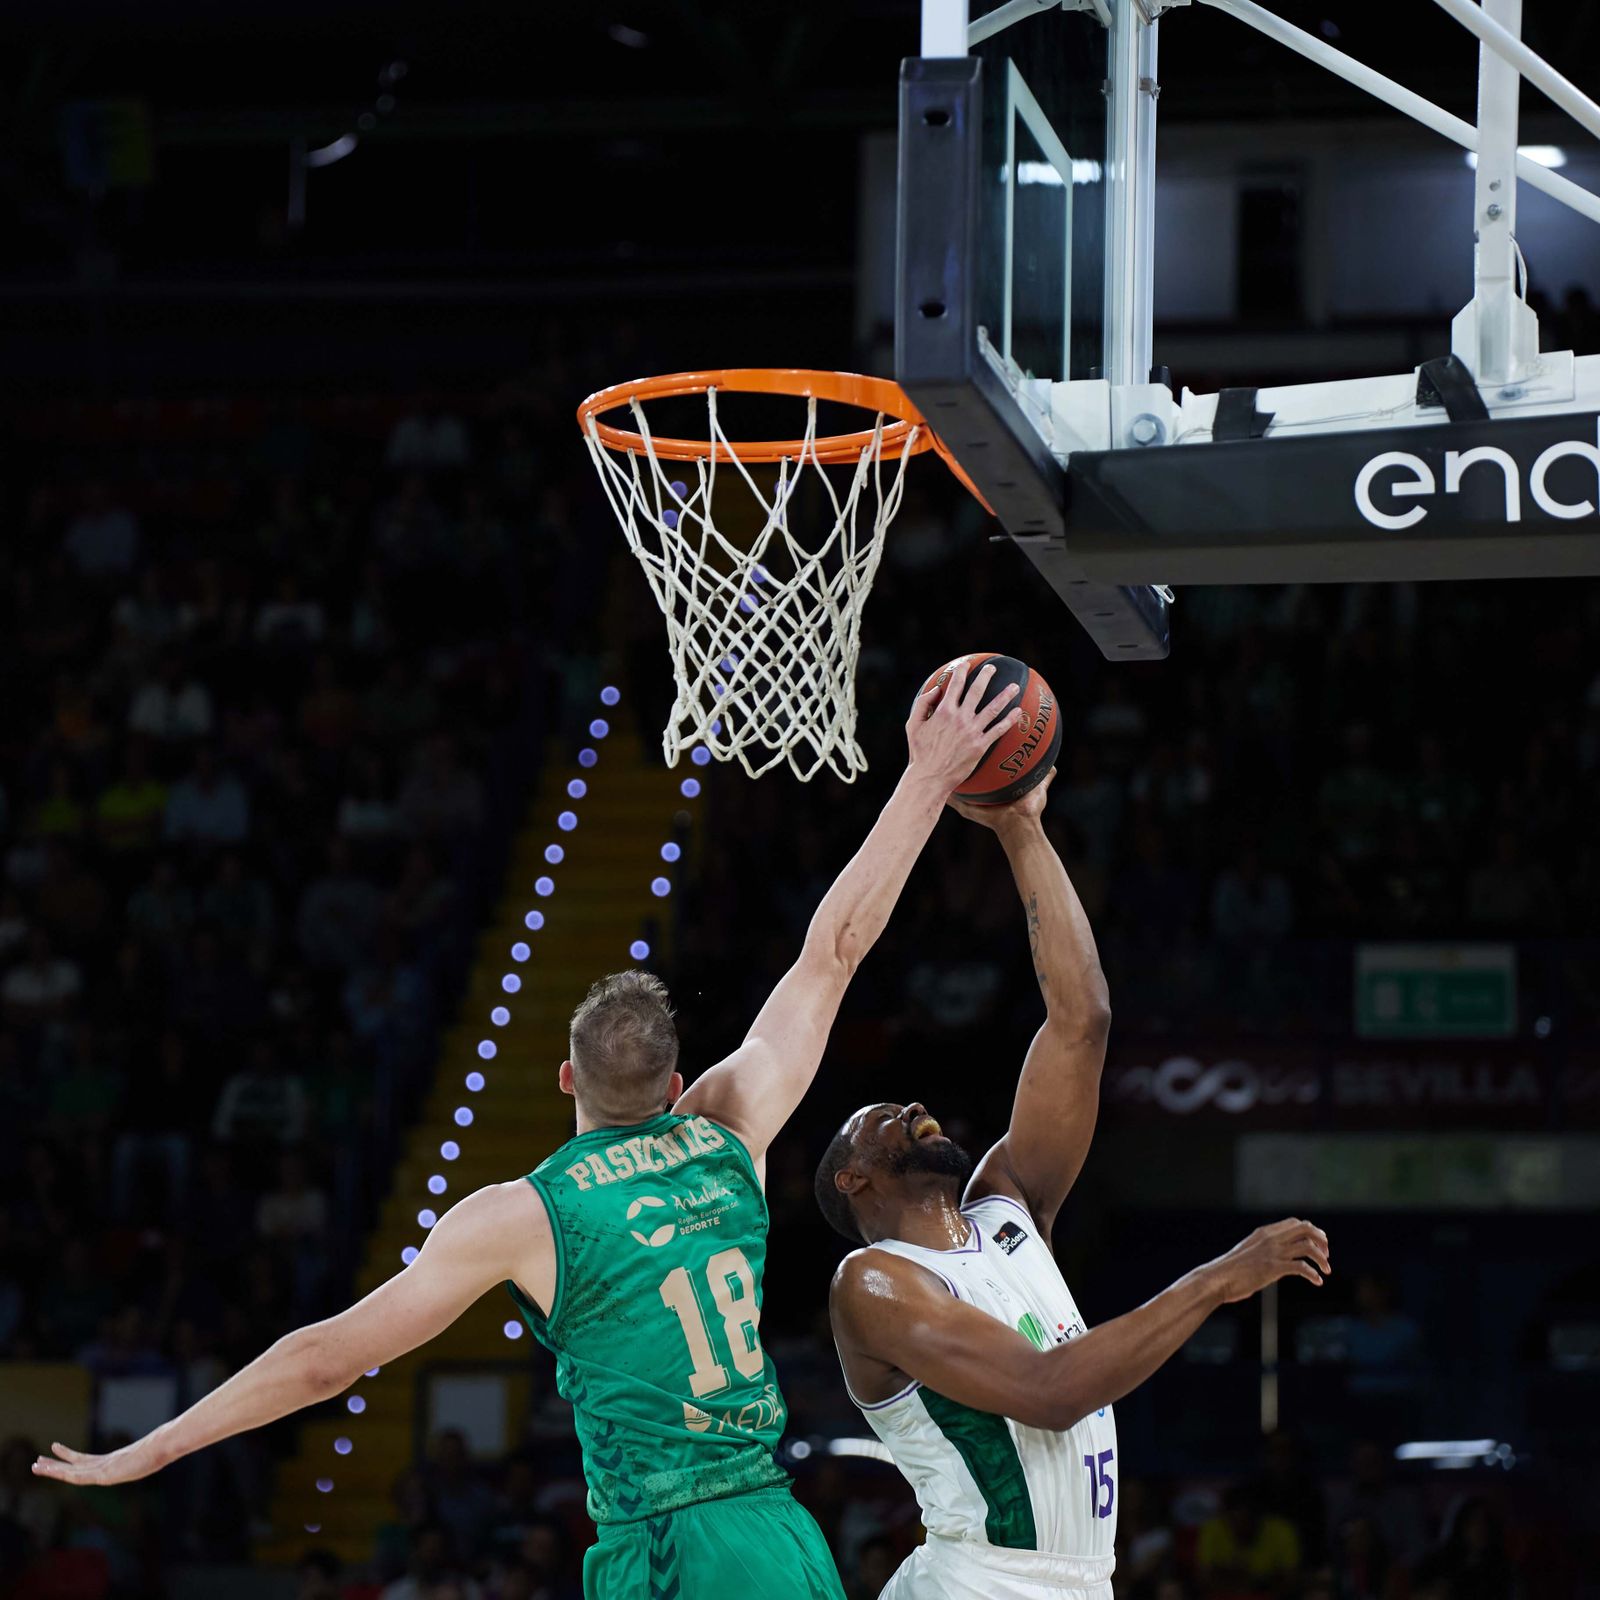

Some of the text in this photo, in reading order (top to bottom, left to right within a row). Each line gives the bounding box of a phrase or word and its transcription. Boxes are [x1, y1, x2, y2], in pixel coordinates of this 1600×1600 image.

[679, 1216, 720, 1235] DEPORTE
[659, 1247, 764, 1400] 18
[1083, 1448, 1114, 1519] 15
